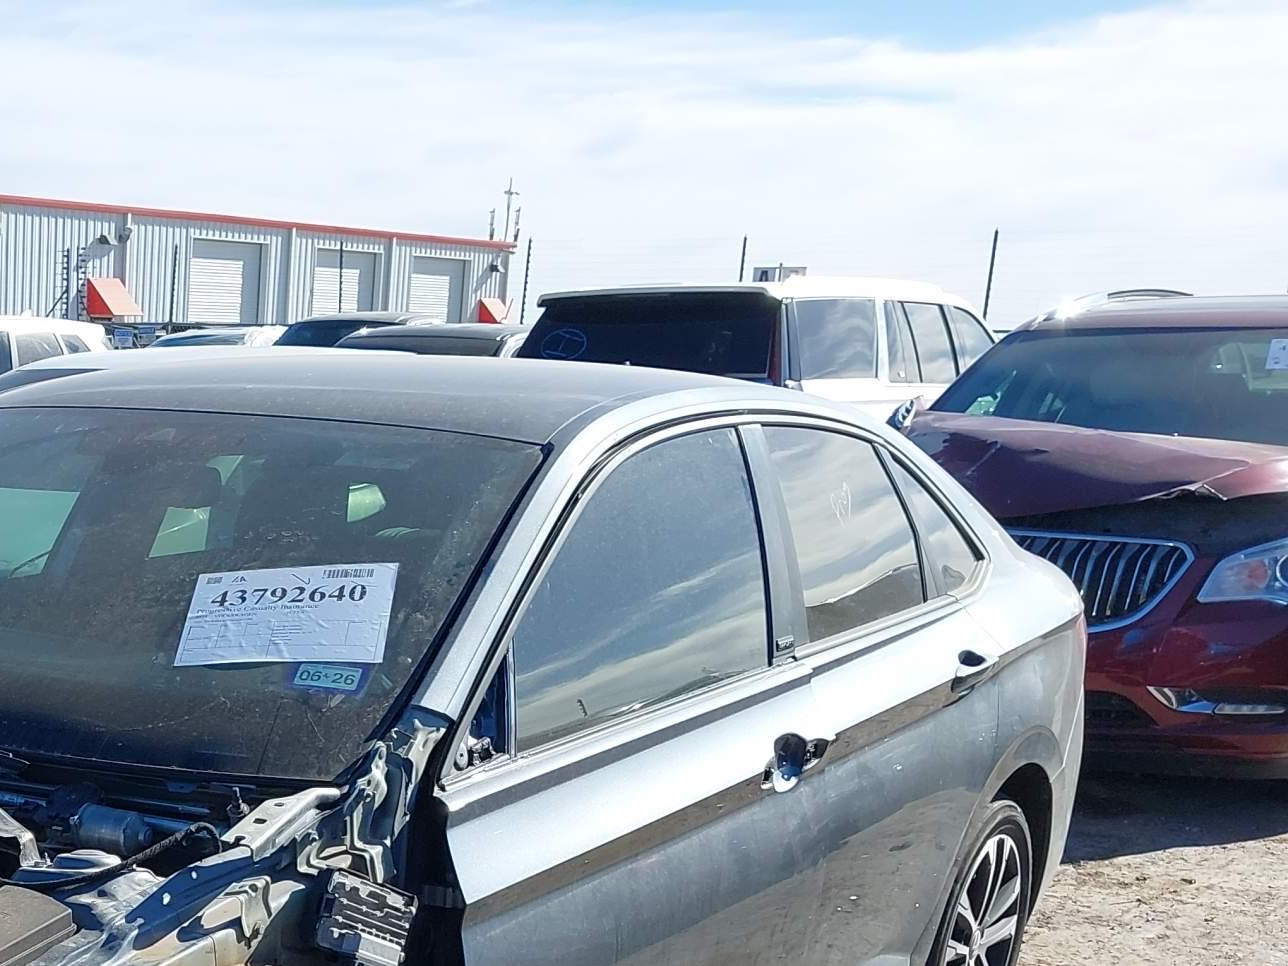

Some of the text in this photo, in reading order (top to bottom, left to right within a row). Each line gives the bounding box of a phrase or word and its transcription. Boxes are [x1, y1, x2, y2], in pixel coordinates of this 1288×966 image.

[210, 584, 368, 607] 43792640
[243, 603, 278, 613] Casualty
[280, 603, 321, 611] Insurance
[298, 669, 356, 686] 06 26
